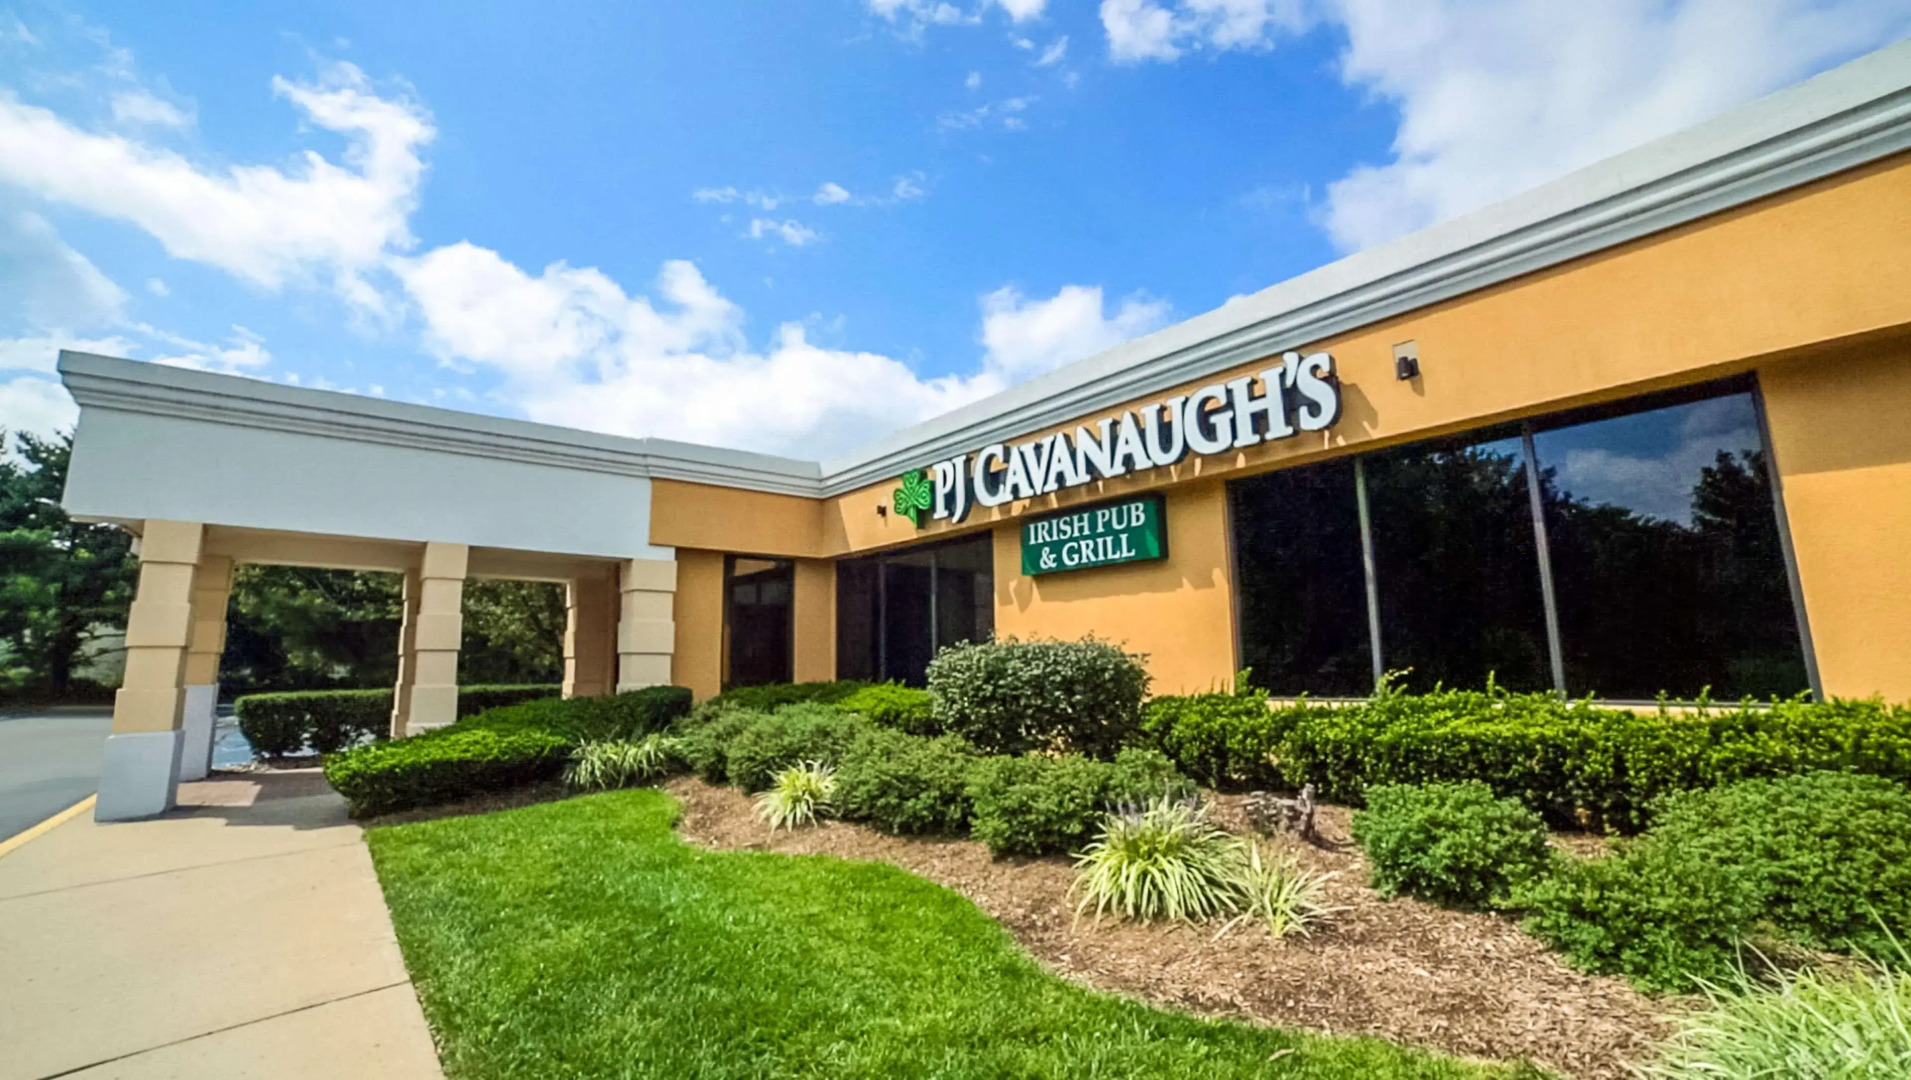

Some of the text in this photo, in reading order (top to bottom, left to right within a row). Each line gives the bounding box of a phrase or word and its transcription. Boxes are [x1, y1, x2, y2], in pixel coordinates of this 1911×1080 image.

[932, 351, 1338, 523] PJ CAVANAUGH'S
[1028, 502, 1146, 545] IRISH PUB
[1039, 534, 1136, 569] & GRILL
